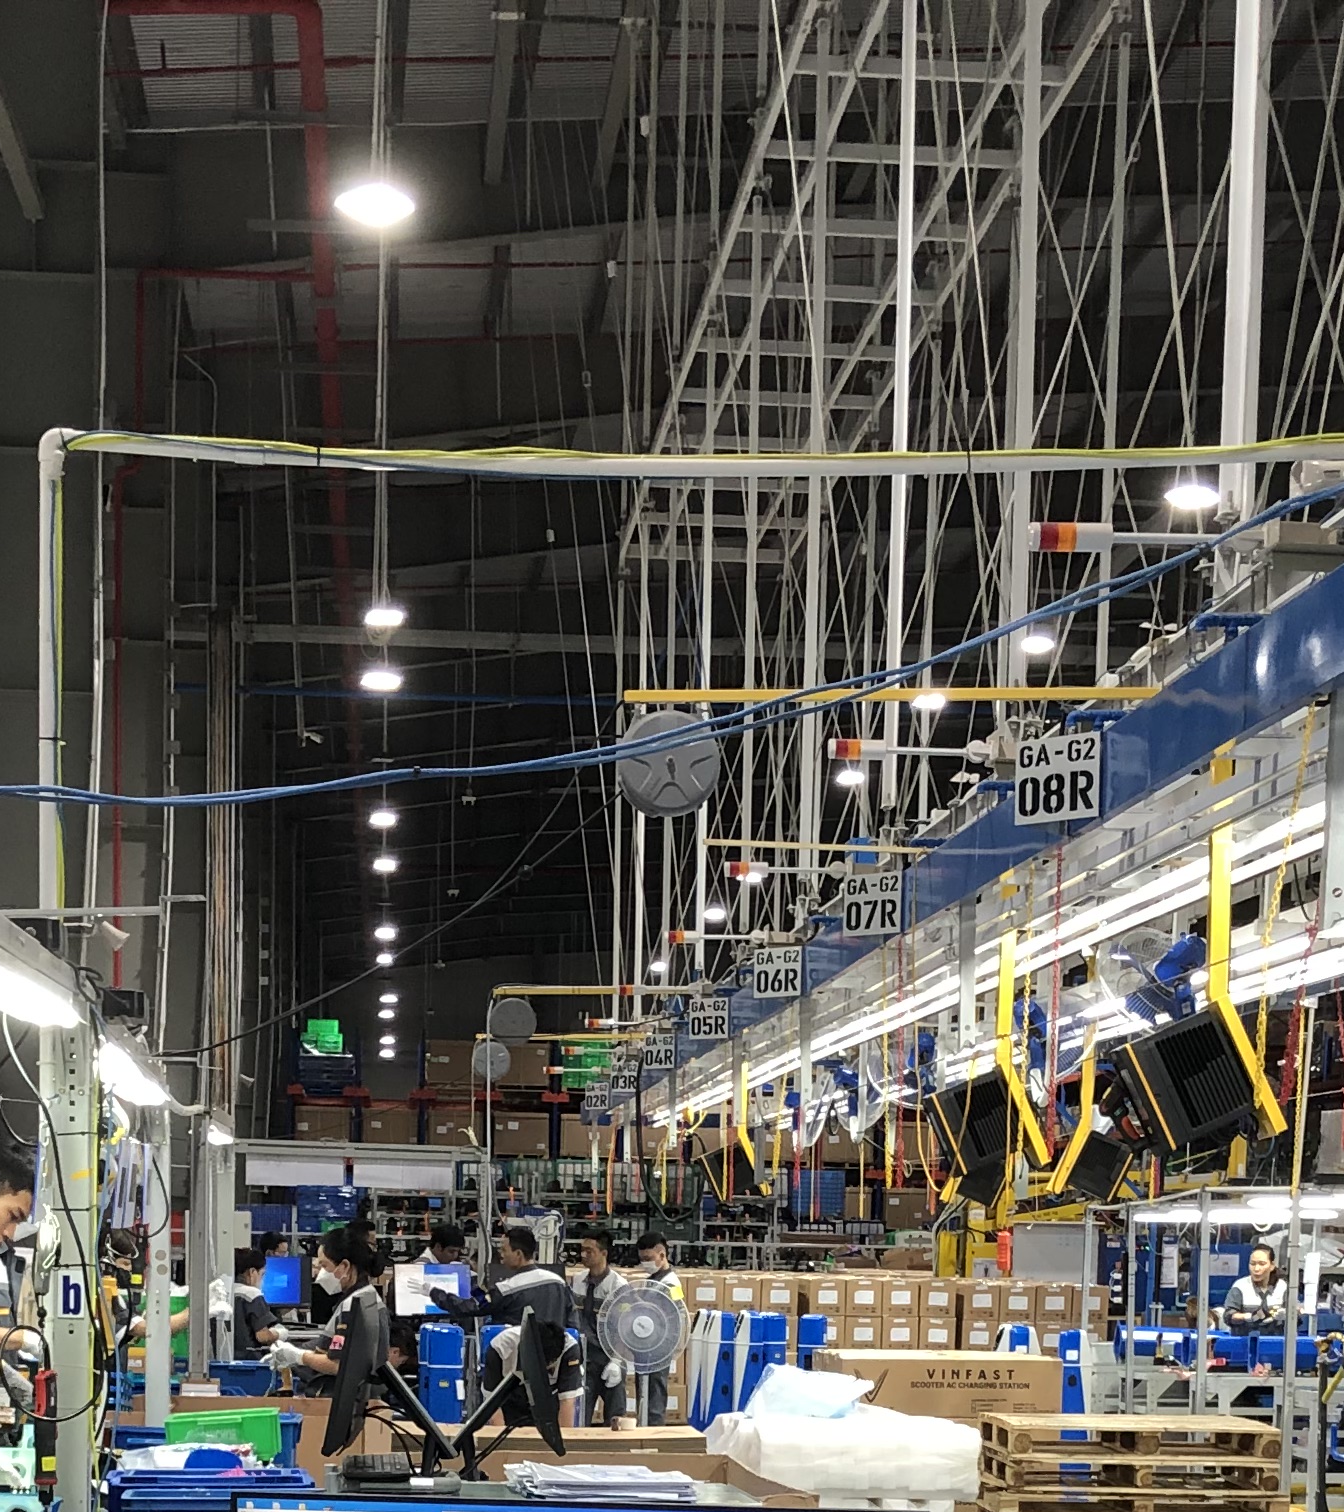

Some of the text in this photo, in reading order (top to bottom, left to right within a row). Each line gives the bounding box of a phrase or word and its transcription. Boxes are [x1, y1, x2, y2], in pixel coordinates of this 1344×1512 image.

[1019, 737, 1096, 769] GA-G2
[1018, 770, 1094, 817] 08R
[847, 875, 899, 896] GA-G2
[846, 899, 897, 931] 07R
[756, 950, 799, 965] GA-G2
[756, 968, 798, 993] 06R
[691, 1000, 727, 1012] GA-G2
[691, 1015, 726, 1036] 05R
[645, 1049, 674, 1067] 04R
[611, 1075, 637, 1090] 03R
[586, 1094, 608, 1108] 02R
[926, 1368, 1015, 1380] VINFAST
[911, 1381, 944, 1389] SCOOTER
[958, 1382, 997, 1390] CHARGING
[998, 1382, 1030, 1390] STATION
